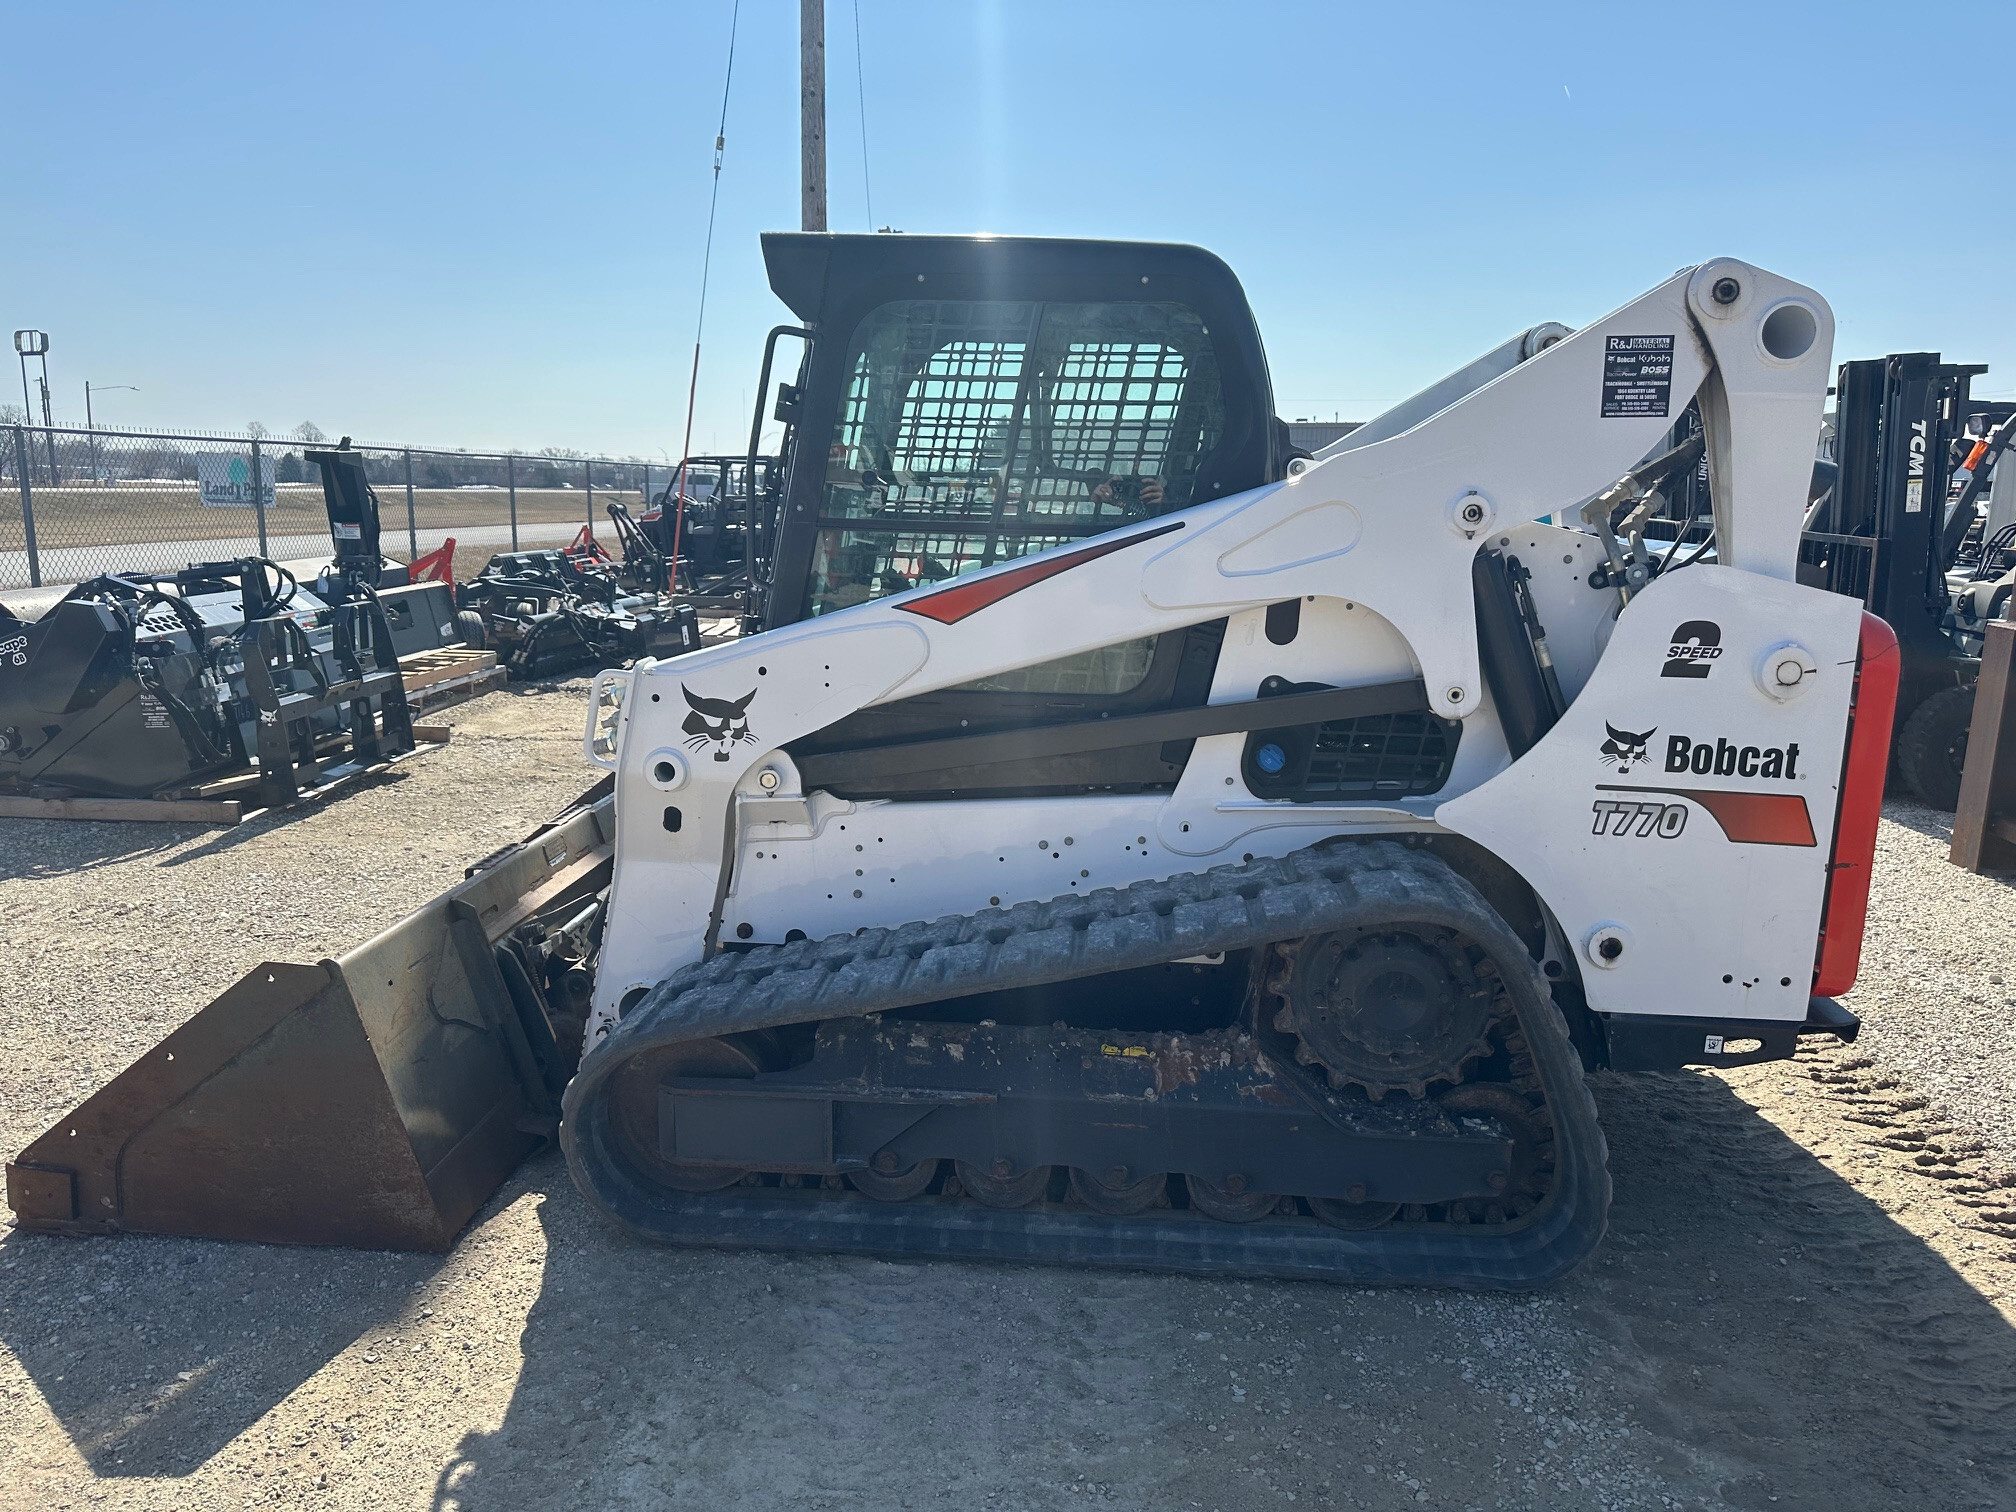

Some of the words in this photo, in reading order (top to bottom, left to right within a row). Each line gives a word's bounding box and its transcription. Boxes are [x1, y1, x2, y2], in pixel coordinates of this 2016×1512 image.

[1610, 338, 1632, 349] R&J
[1639, 354, 1671, 363] Kubota
[1641, 366, 1670, 374] BOSS
[1908, 419, 1927, 476] TCM
[204, 480, 235, 496] Land
[242, 482, 273, 497] Prde
[13, 652, 27, 666] 6B
[1666, 645, 1723, 659] SPEED
[1664, 735, 1800, 780] Bobcat
[1592, 800, 1689, 839] T770
